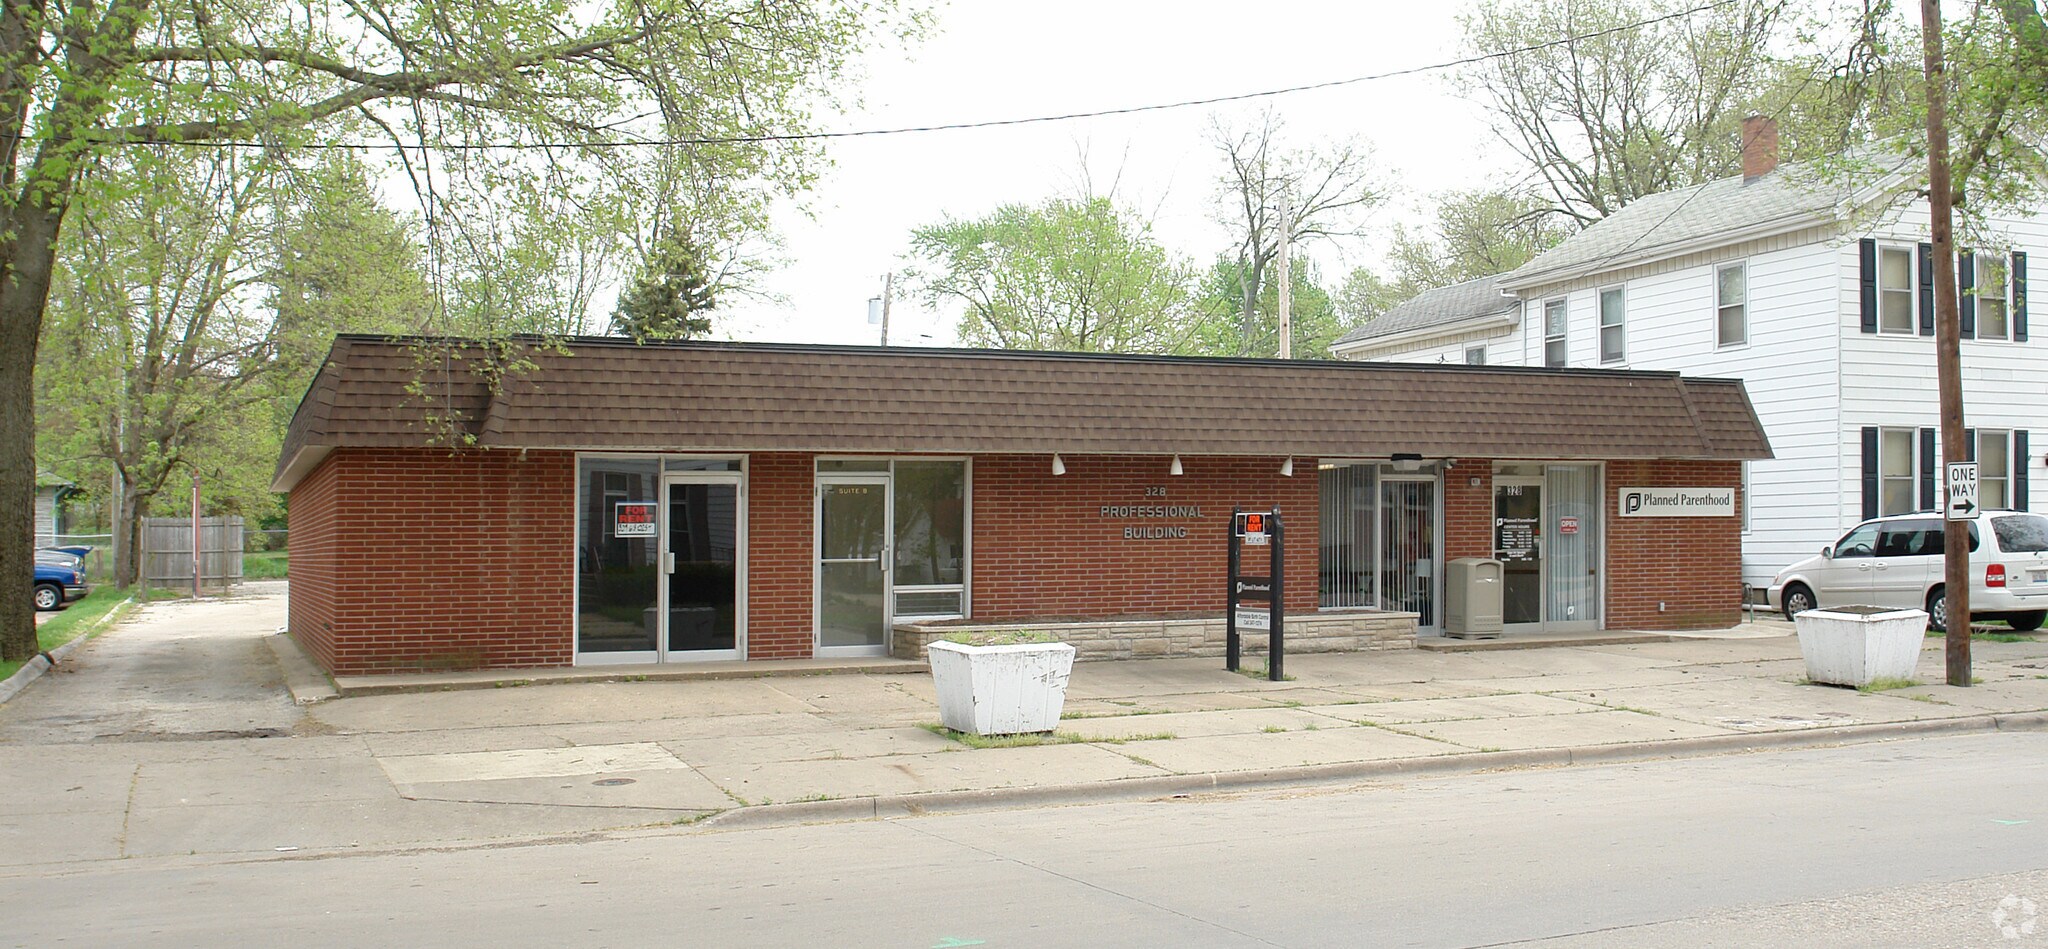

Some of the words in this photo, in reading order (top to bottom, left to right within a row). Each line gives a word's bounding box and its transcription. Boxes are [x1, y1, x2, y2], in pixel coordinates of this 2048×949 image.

[1952, 468, 1975, 481] ONE
[1145, 487, 1166, 497] 328
[1507, 485, 1522, 496] 328
[1952, 483, 1976, 497] WAY
[1643, 493, 1679, 506] Planned
[1681, 493, 1730, 506] Parenthood
[625, 506, 647, 515] FOR
[1100, 505, 1205, 518] PROFESSIONAL
[618, 515, 653, 523] RENT
[1249, 515, 1260, 524] FOR
[1124, 526, 1187, 539] BUILDING
[1247, 523, 1262, 532] RENT
